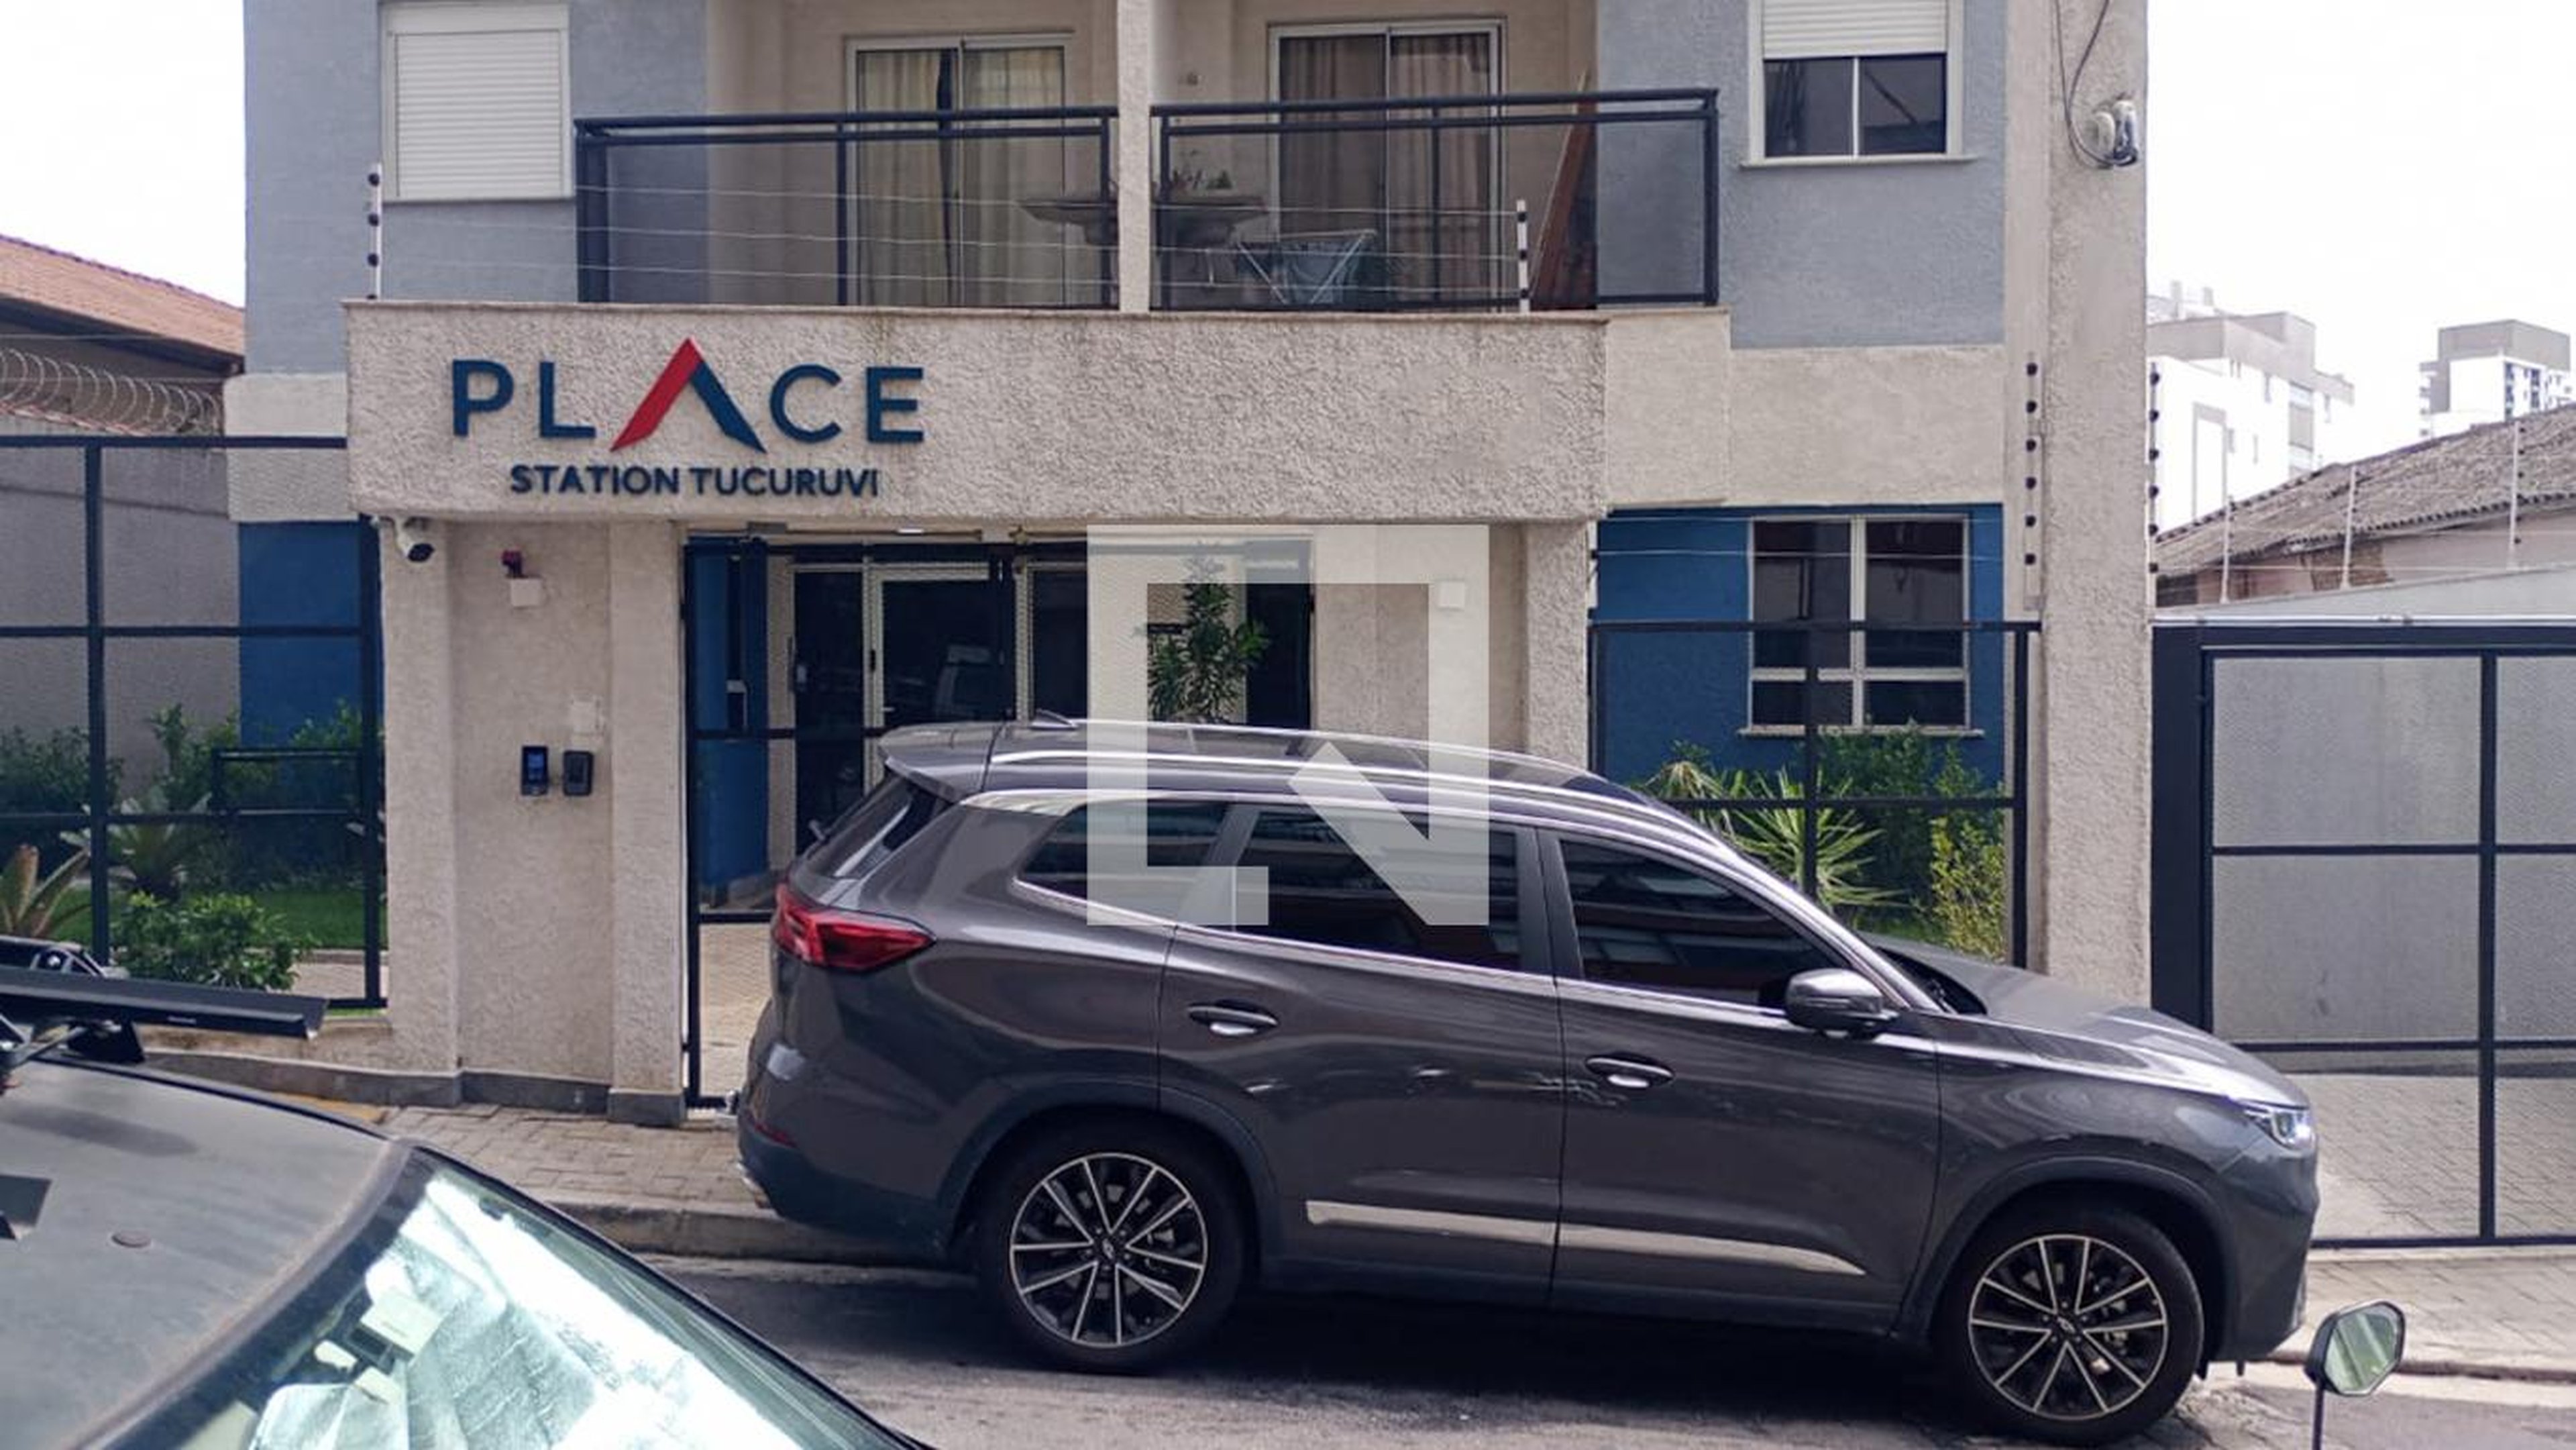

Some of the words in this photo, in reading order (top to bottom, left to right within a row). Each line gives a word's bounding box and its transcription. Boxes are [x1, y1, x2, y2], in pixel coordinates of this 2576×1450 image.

[451, 338, 924, 453] PLACE
[511, 464, 680, 496] STATION
[691, 468, 879, 498] TUCURUVI
